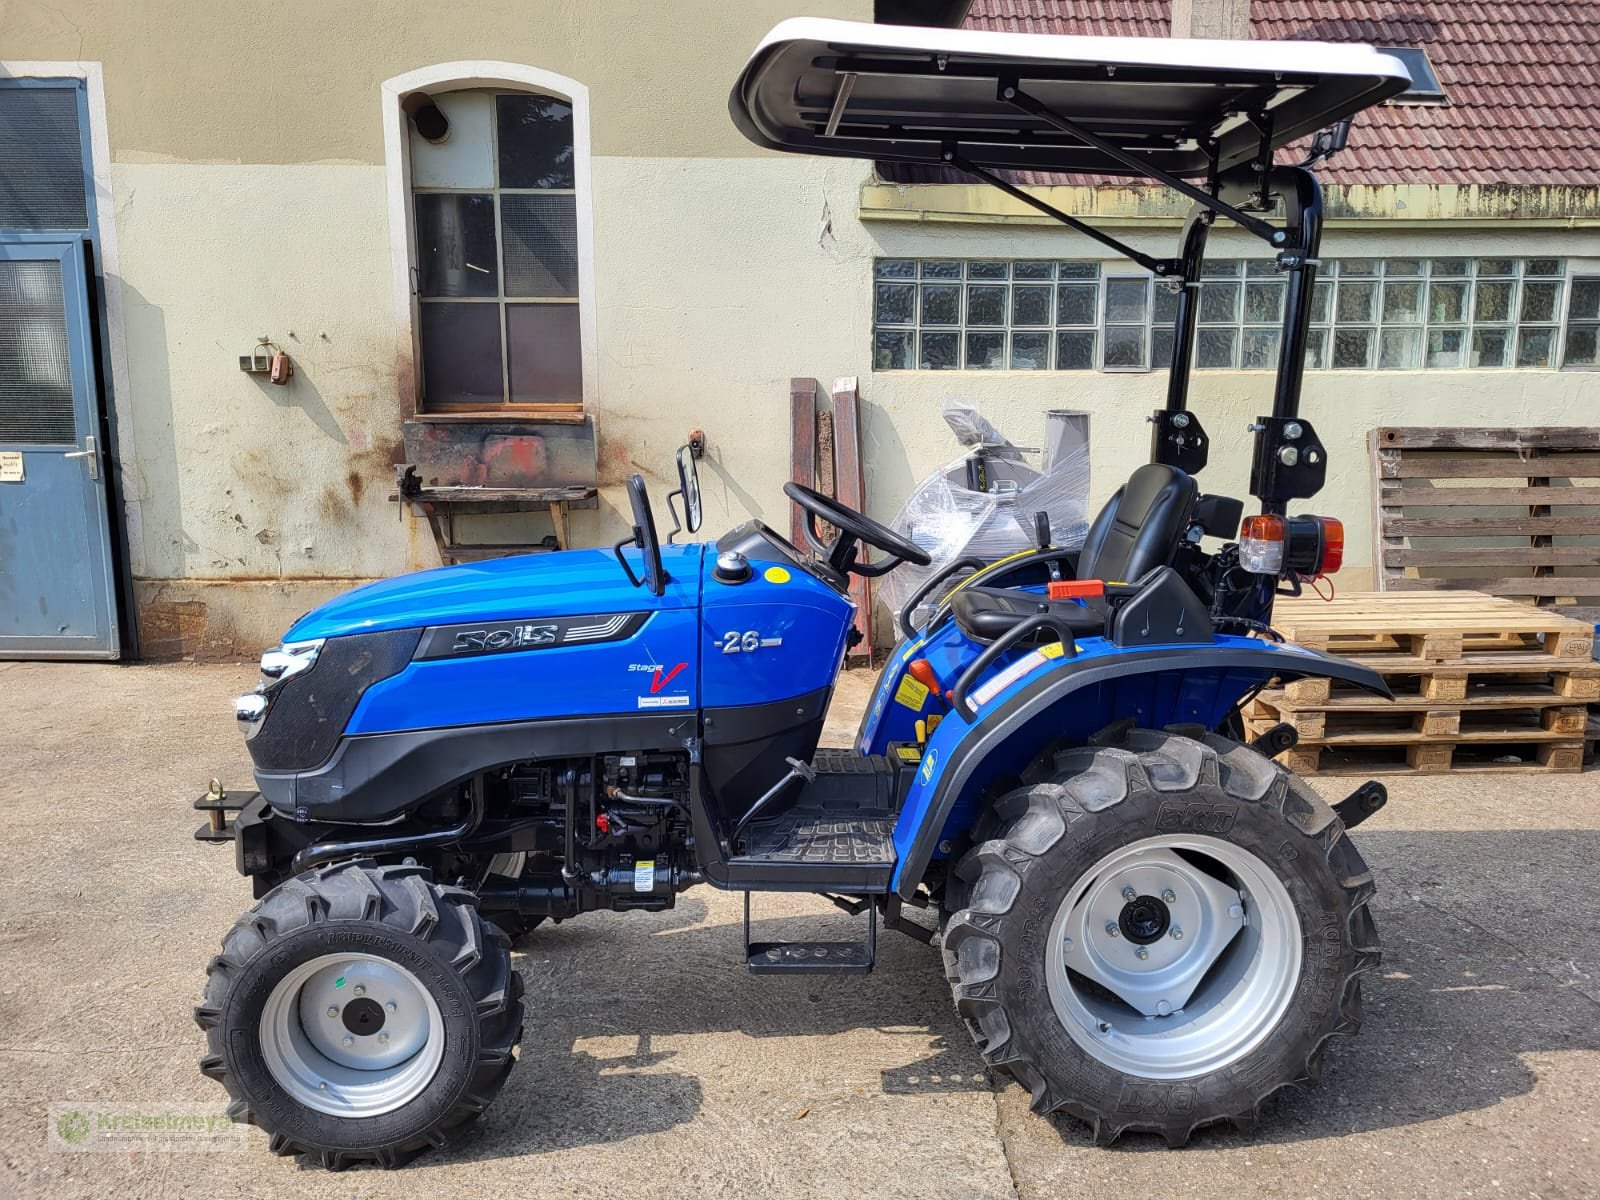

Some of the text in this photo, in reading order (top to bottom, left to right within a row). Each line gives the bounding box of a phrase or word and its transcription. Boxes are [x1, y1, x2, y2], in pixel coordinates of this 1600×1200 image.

[722, 631, 760, 654] 26
[628, 663, 664, 673] Stage
[650, 663, 689, 694] V
[1155, 801, 1238, 834] BKT
